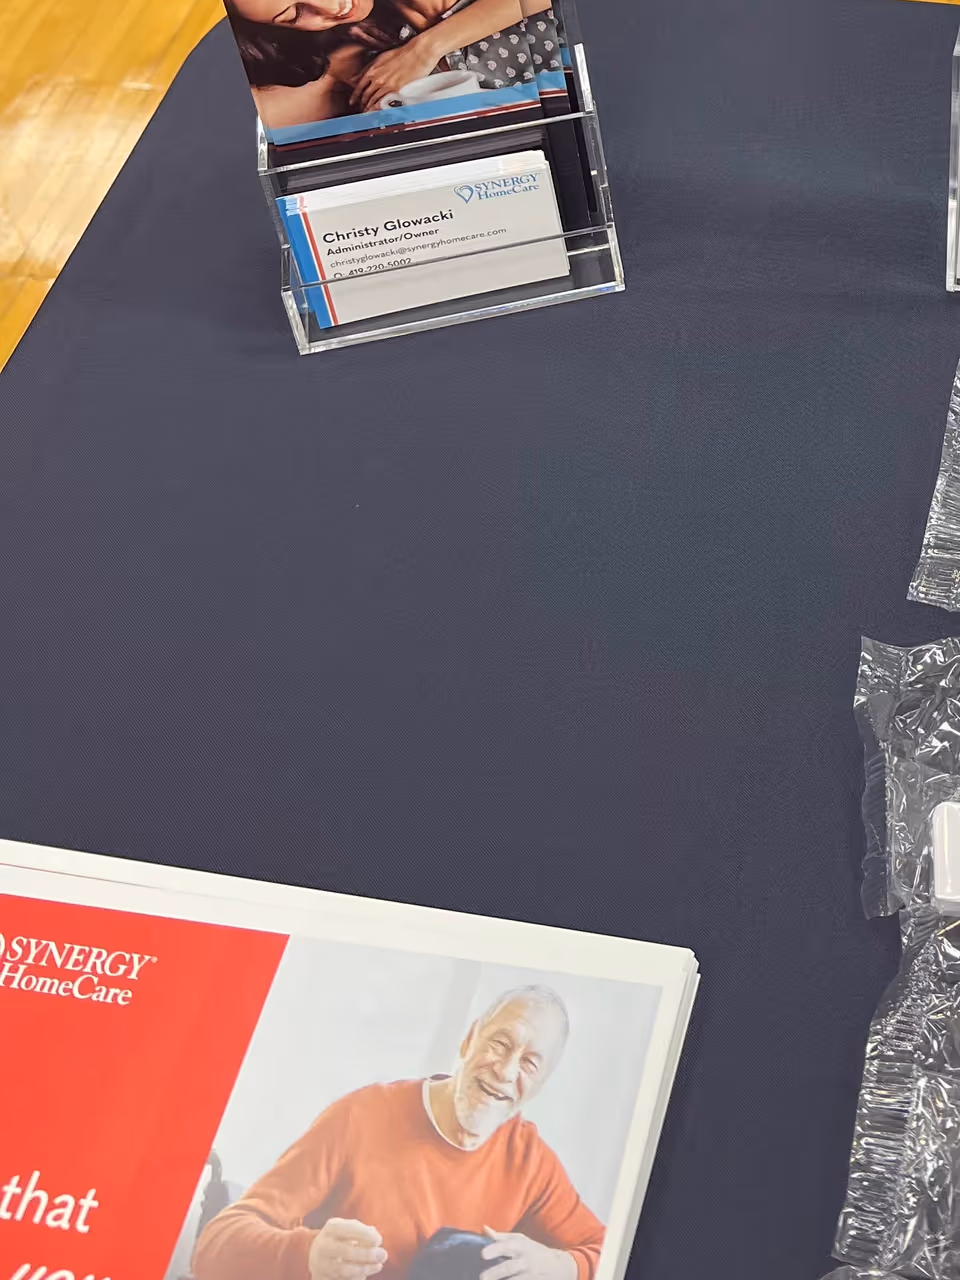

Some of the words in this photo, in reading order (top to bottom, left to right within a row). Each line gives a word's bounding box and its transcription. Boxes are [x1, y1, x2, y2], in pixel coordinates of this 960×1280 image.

[477, 183, 540, 201] HomeCare
[322, 224, 380, 244] Christy
[384, 209, 454, 231] Glowacki
[326, 228, 440, 256] Administrator/Owner
[0, 961, 133, 1006] HomeCare
[0, 1170, 99, 1233] that
